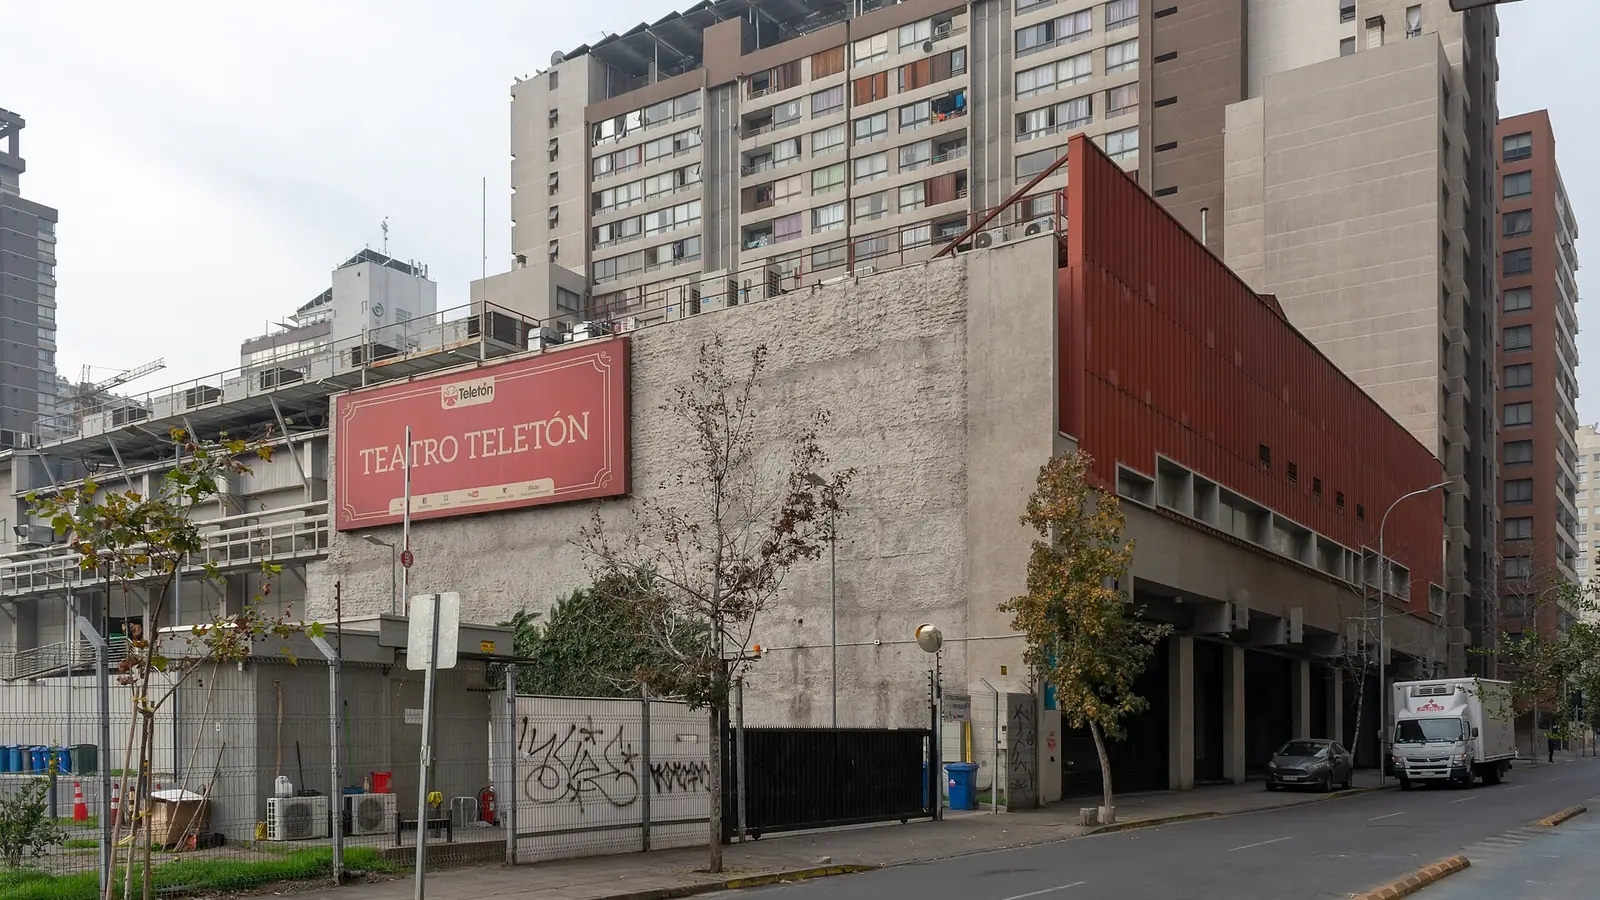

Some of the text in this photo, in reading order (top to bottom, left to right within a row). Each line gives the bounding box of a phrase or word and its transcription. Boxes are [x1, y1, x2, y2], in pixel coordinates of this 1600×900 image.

[459, 382, 493, 400] Teletón
[359, 410, 590, 475] TEATRO TELETÓN
